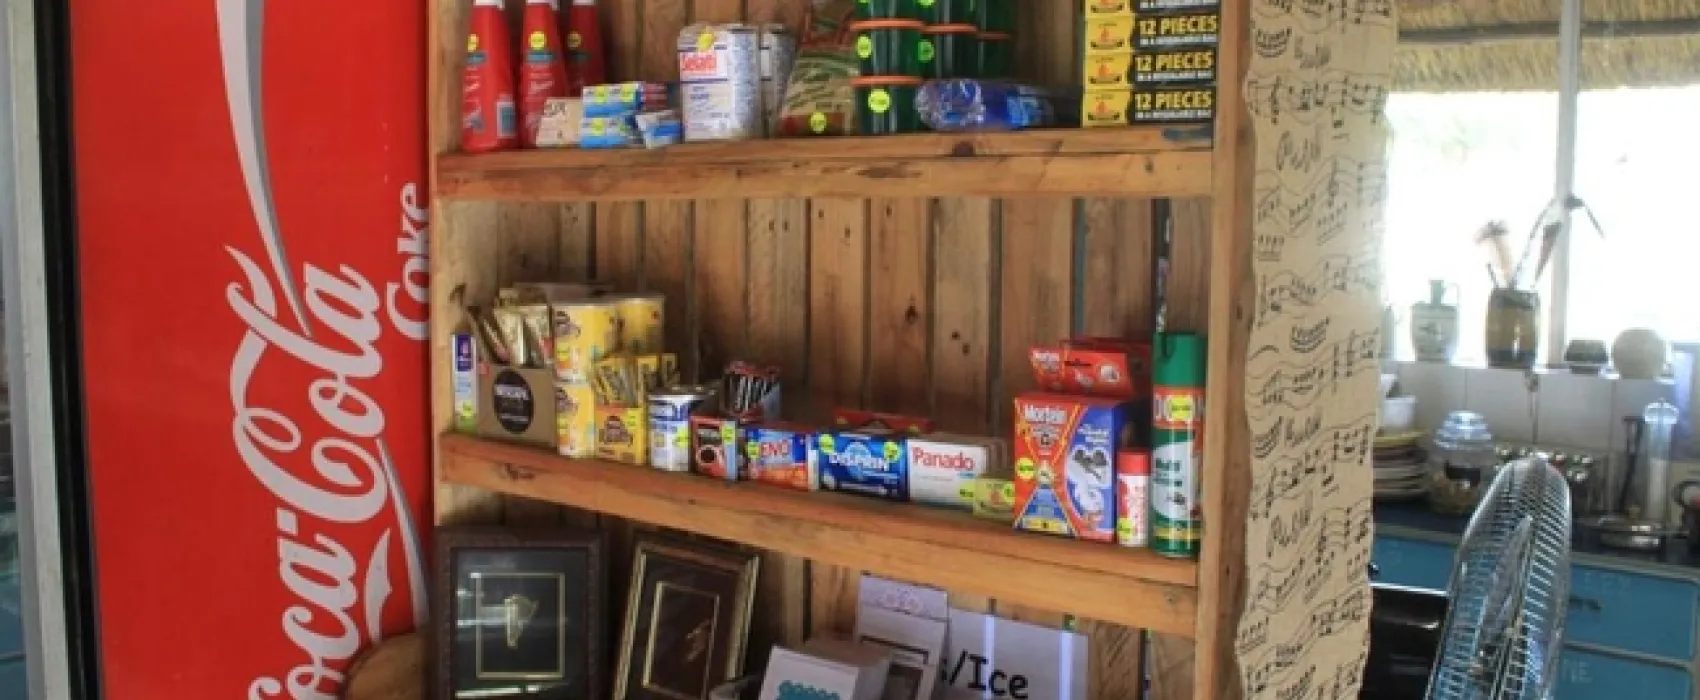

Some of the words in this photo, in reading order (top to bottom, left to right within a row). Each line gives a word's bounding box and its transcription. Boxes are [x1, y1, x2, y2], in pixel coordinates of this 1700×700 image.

[1139, 20, 1157, 35] 12
[1160, 15, 1219, 35] PIECES
[1135, 56, 1152, 72] 12
[1155, 51, 1213, 71] PIECES
[1135, 93, 1152, 110] 12
[1155, 91, 1212, 109] PIECES
[386, 183, 429, 340] Coke
[760, 440, 789, 459] ENO
[911, 446, 976, 472] Panado
